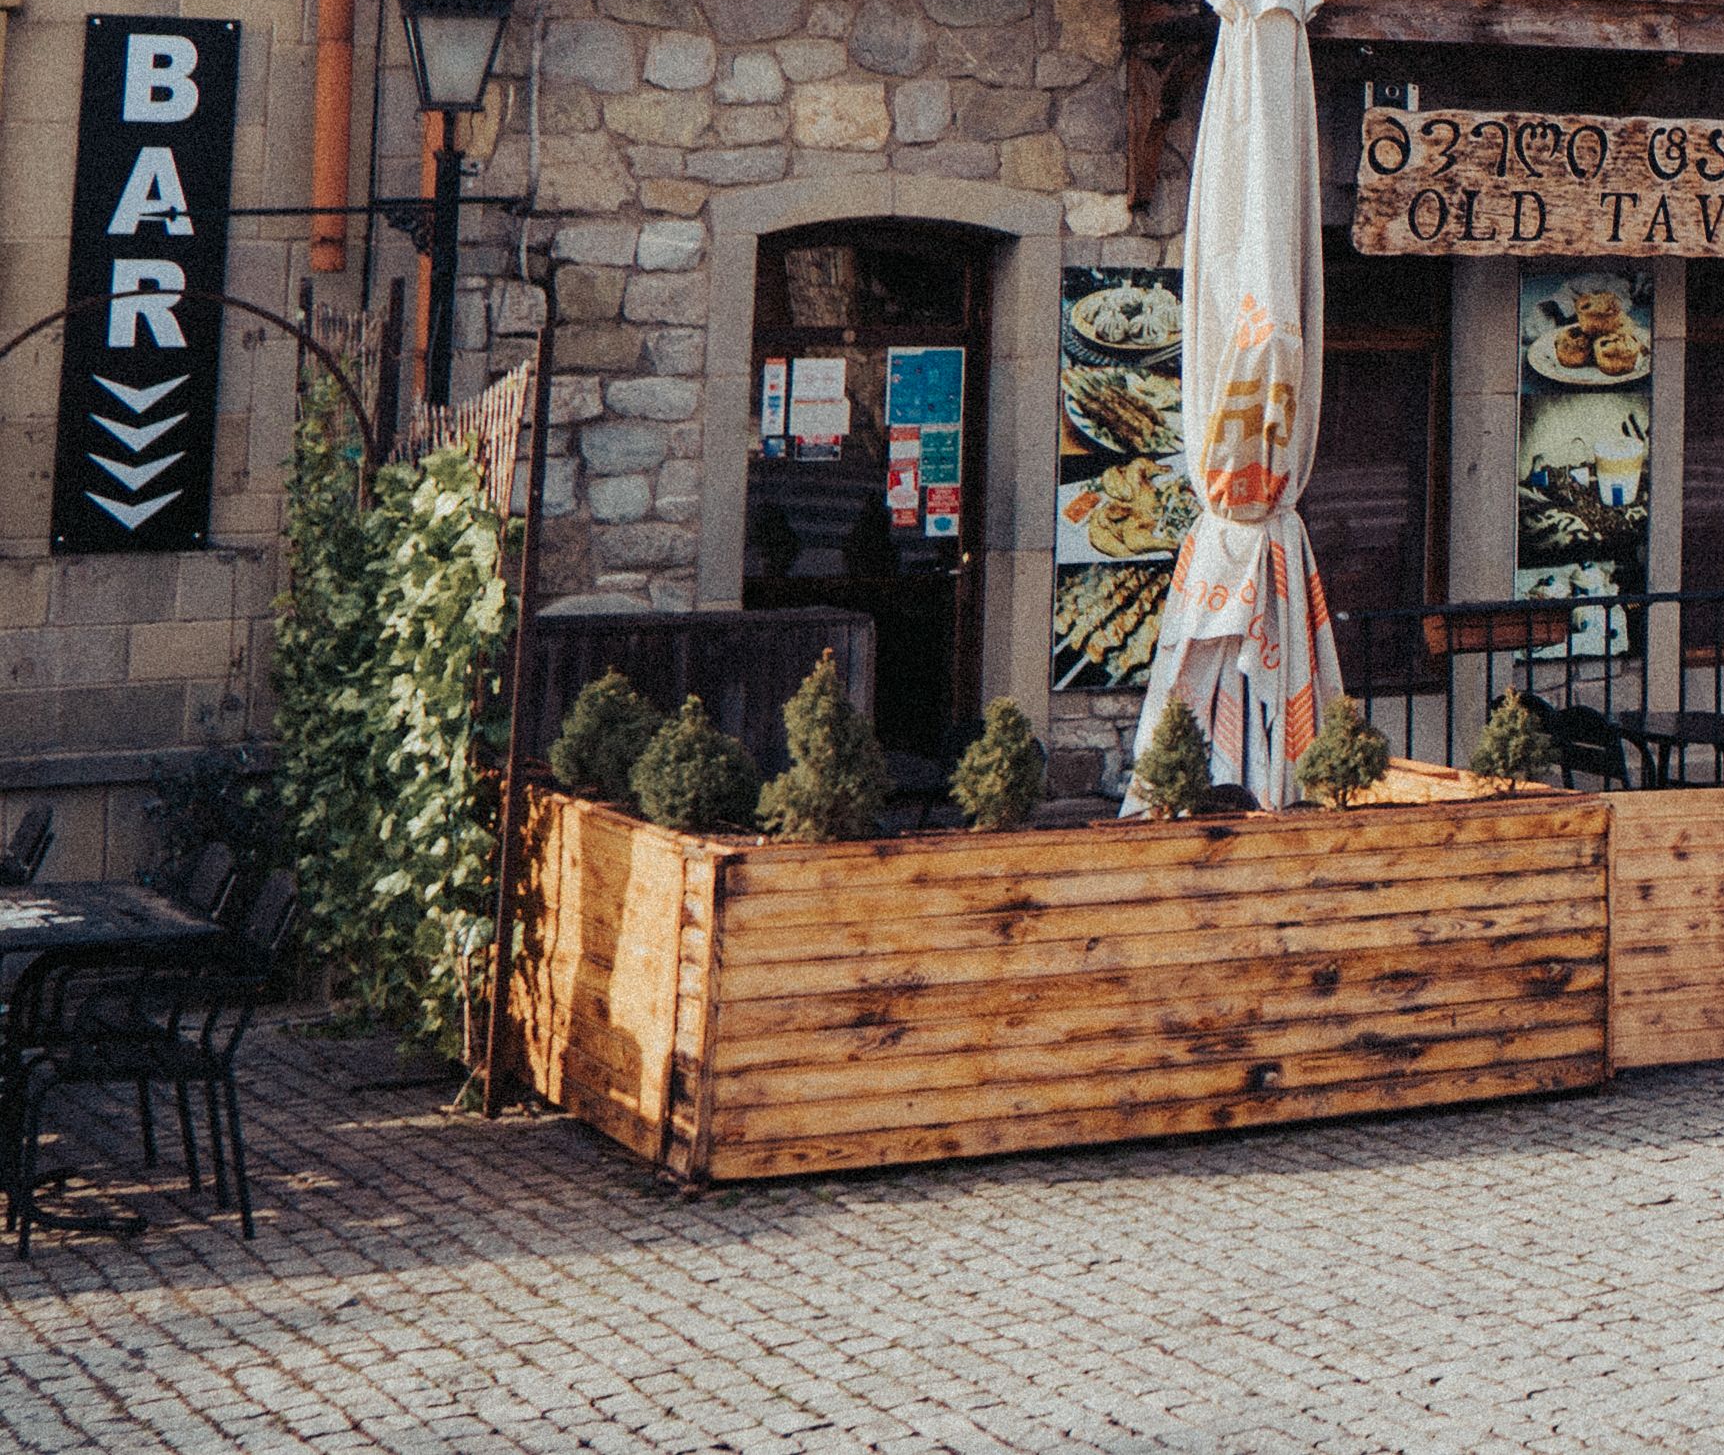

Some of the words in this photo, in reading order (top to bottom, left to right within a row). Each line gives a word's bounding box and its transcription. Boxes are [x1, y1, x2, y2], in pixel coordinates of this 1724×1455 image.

[1367, 116, 1609, 180] ძველი
[106, 33, 199, 348] BAR
[1407, 187, 1547, 242] OLD
